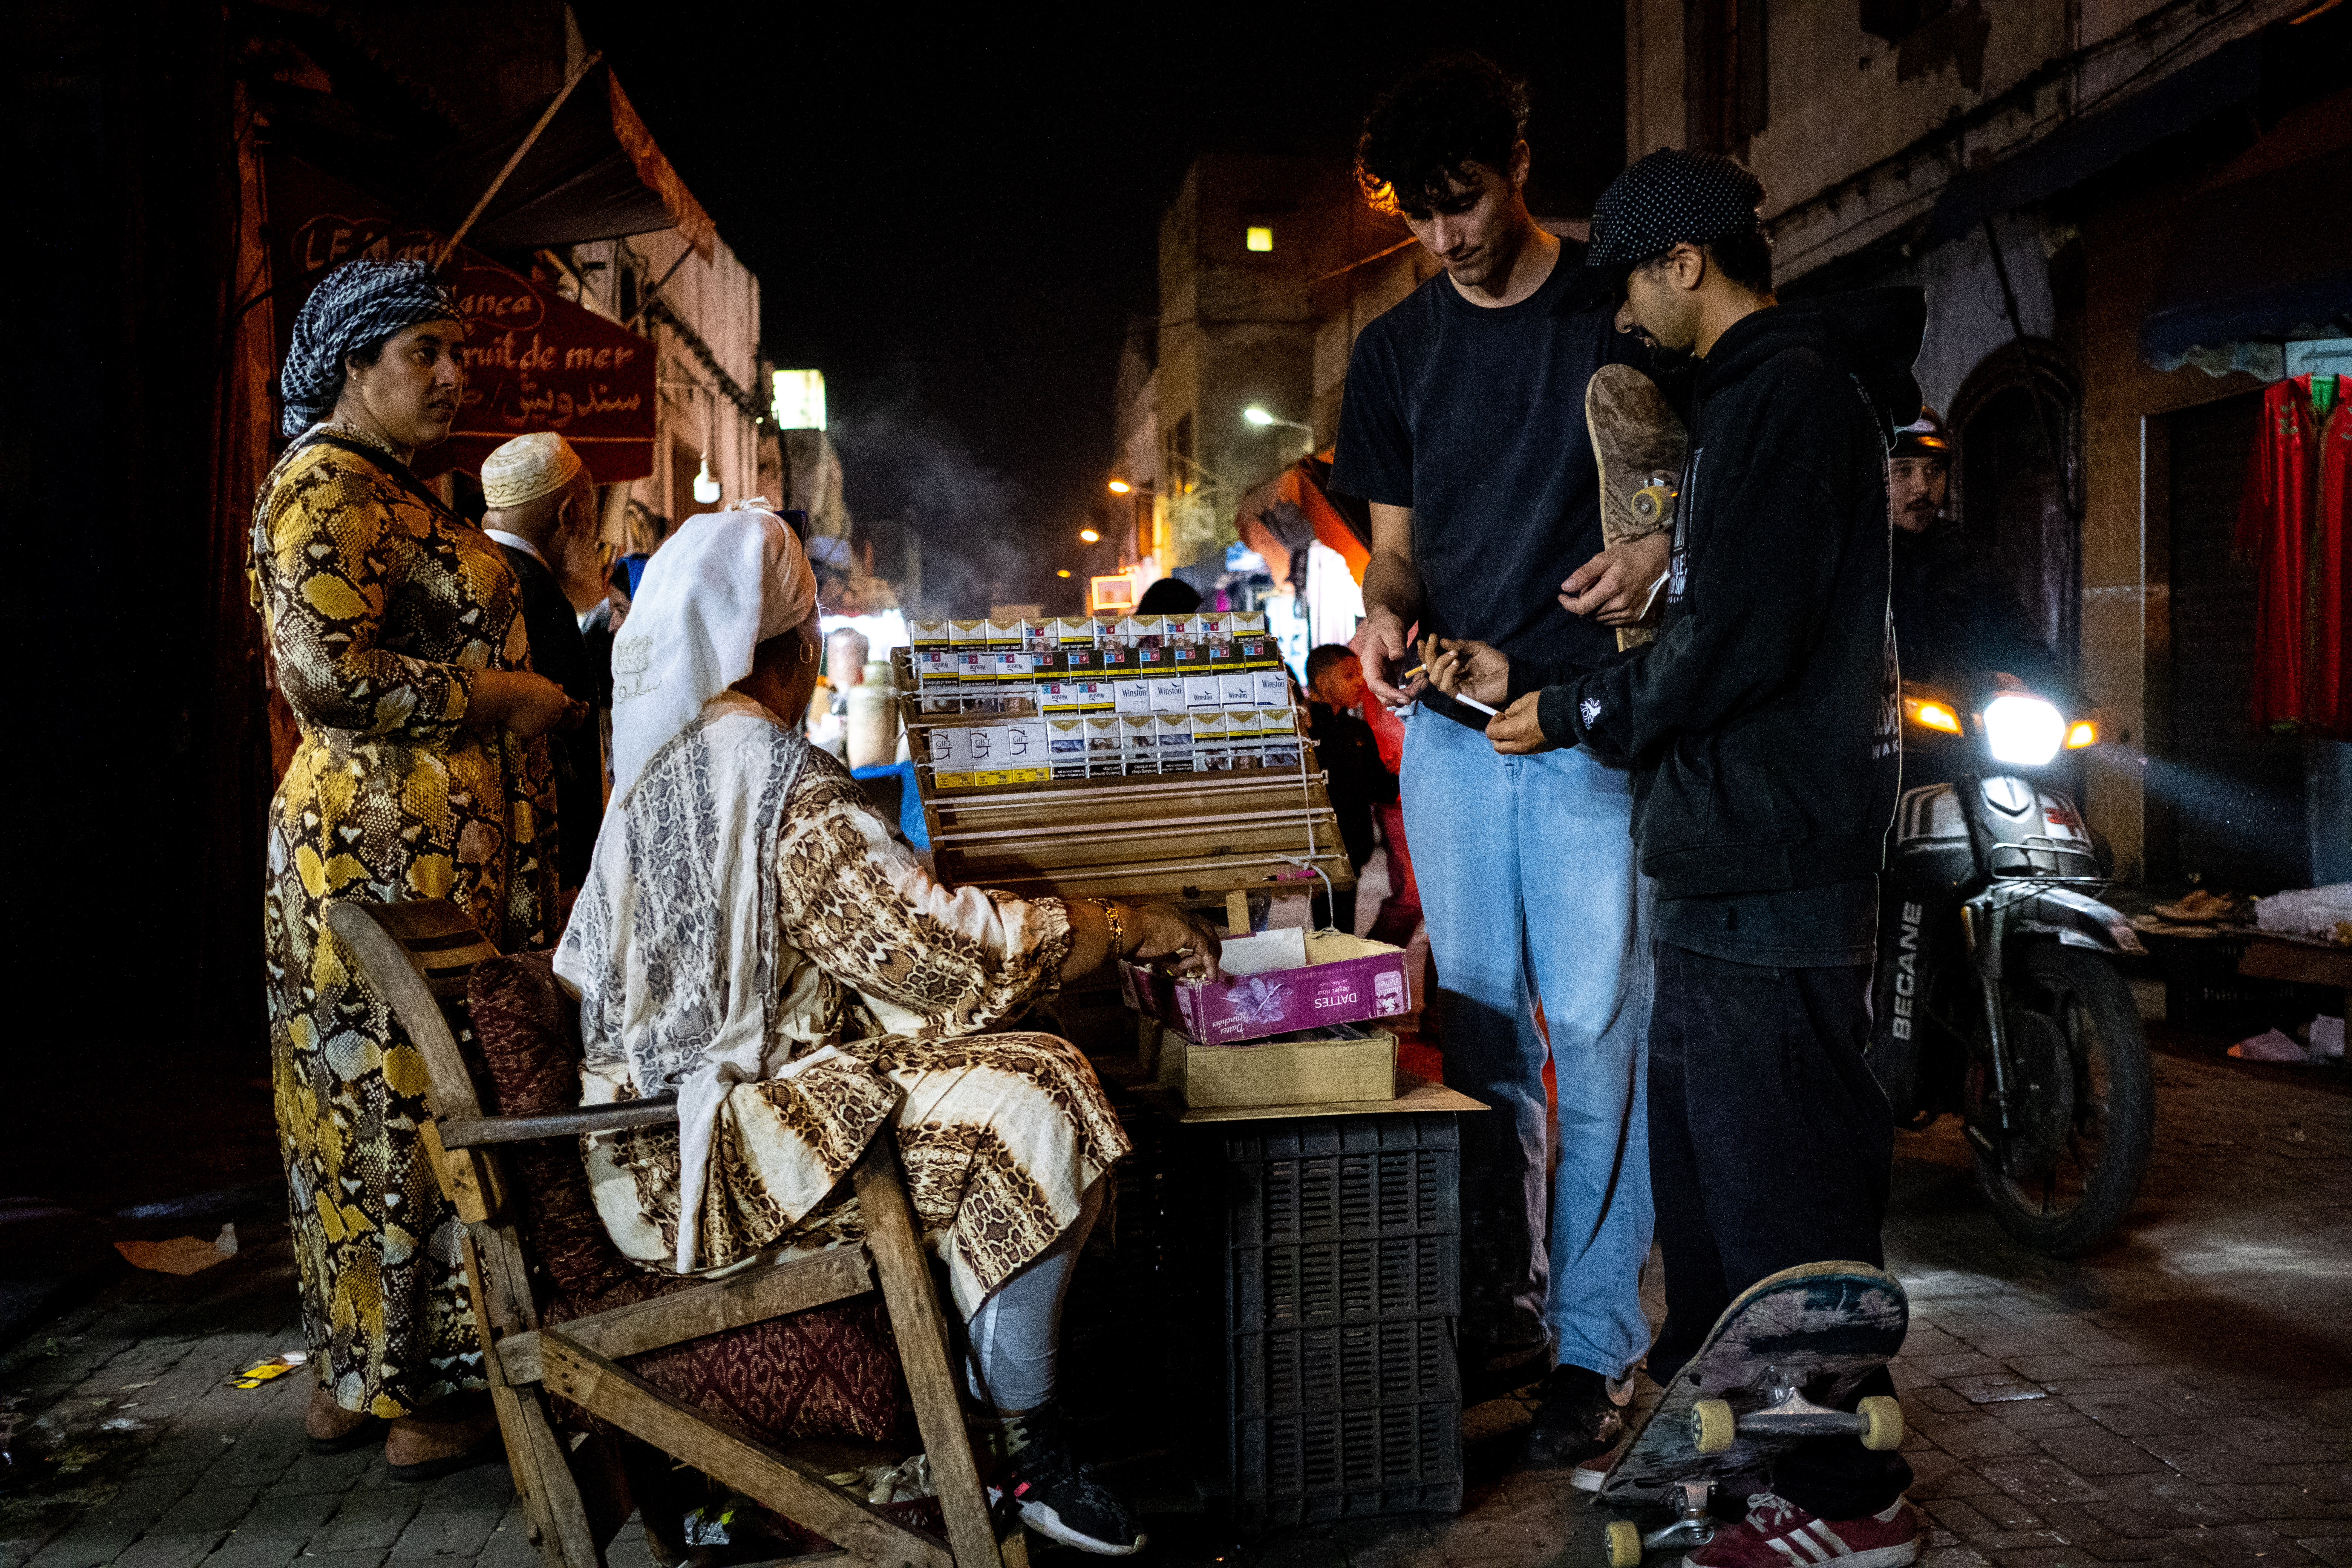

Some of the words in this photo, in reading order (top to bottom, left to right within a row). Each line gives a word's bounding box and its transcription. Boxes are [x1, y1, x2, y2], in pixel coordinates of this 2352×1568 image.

[452, 285, 533, 317] anca
[462, 329, 517, 370] ruit
[519, 333, 557, 371] de
[565, 345, 635, 371] mer
[1262, 679, 1285, 688] Winston
[1122, 688, 1146, 697] Winston
[1157, 686, 1182, 695] Winston
[1892, 901, 1922, 1041] BECANE
[1377, 977, 1399, 988] Dattes
[1332, 986, 1350, 994] deglet
[1314, 992, 1357, 1009] DATTES
[1212, 1012, 1250, 1028] Branchées
[1220, 1023, 1244, 1034] Dattes
